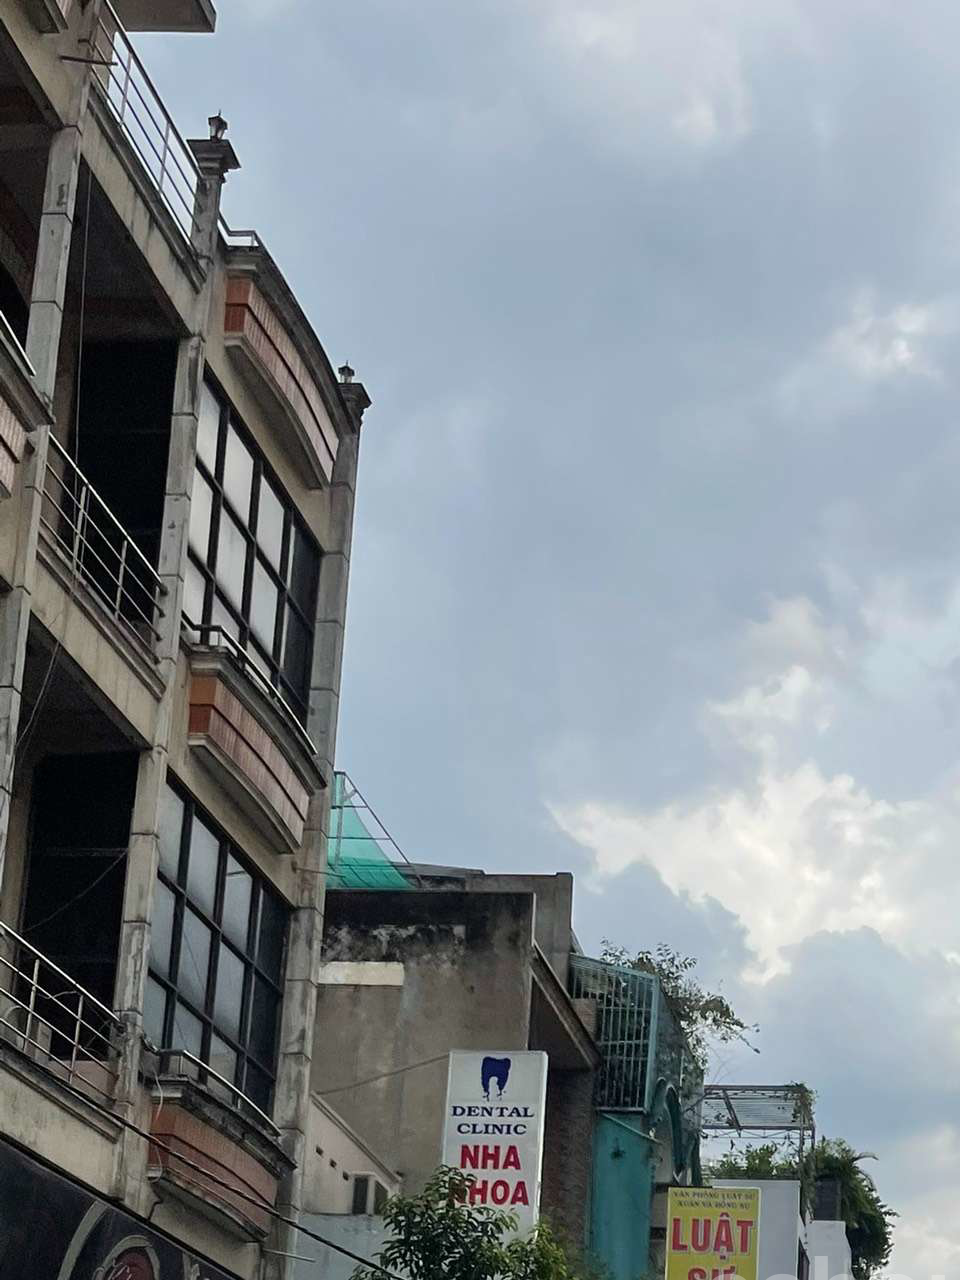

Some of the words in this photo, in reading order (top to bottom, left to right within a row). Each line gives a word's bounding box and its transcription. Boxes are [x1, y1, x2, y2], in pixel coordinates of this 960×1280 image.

[452, 1106, 534, 1118] DENTAL
[457, 1123, 527, 1135] CLINIC
[460, 1144, 521, 1170] NHA
[672, 1212, 753, 1260] LUẬT
